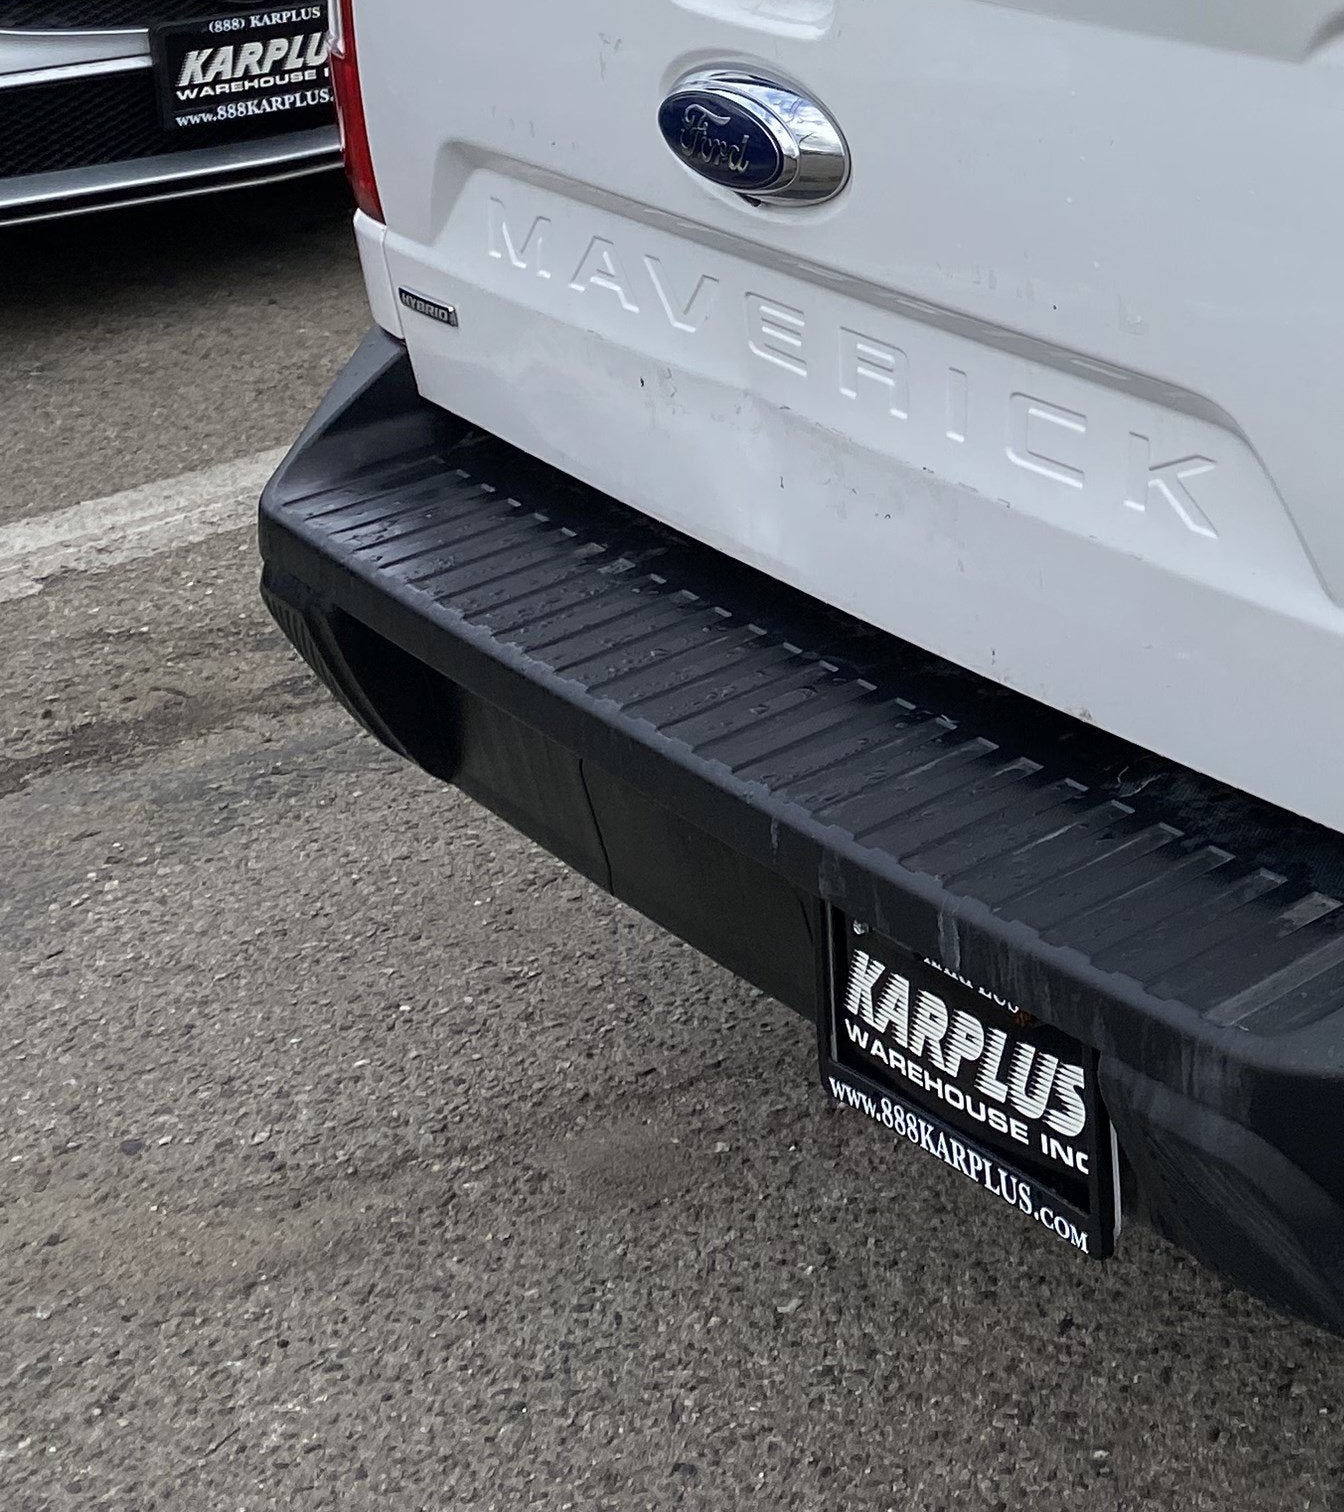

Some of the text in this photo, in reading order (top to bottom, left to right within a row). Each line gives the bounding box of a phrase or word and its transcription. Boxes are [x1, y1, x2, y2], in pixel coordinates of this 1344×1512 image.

[208, 6, 321, 33] (888) KARPLUS
[177, 69, 317, 101] WAREHOUSE
[680, 103, 751, 173] Ford
[401, 292, 449, 321] HYBRID
[488, 195, 1218, 540] MAVERICK
[844, 948, 1087, 1138] KARPLUS
[845, 1017, 1090, 1175] WAREHOUSE INC
